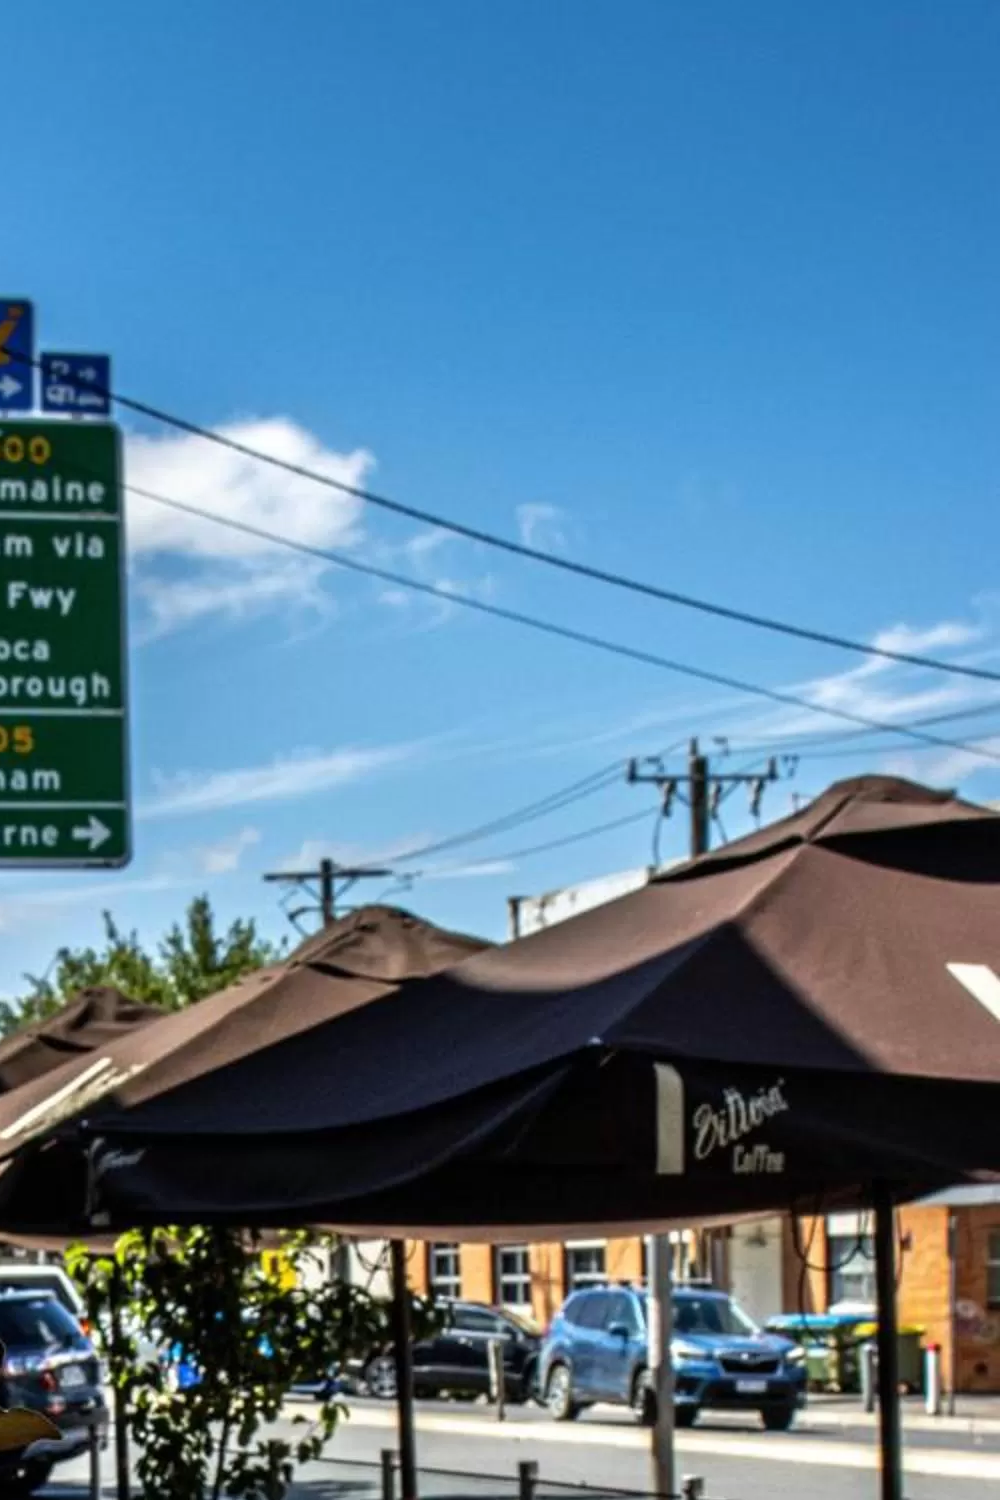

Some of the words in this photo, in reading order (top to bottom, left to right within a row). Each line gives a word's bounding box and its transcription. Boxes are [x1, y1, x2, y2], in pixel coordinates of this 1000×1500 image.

[52, 533, 105, 559] via
[7, 581, 76, 616] Fwy
[732, 1143, 785, 1174] Coffee
